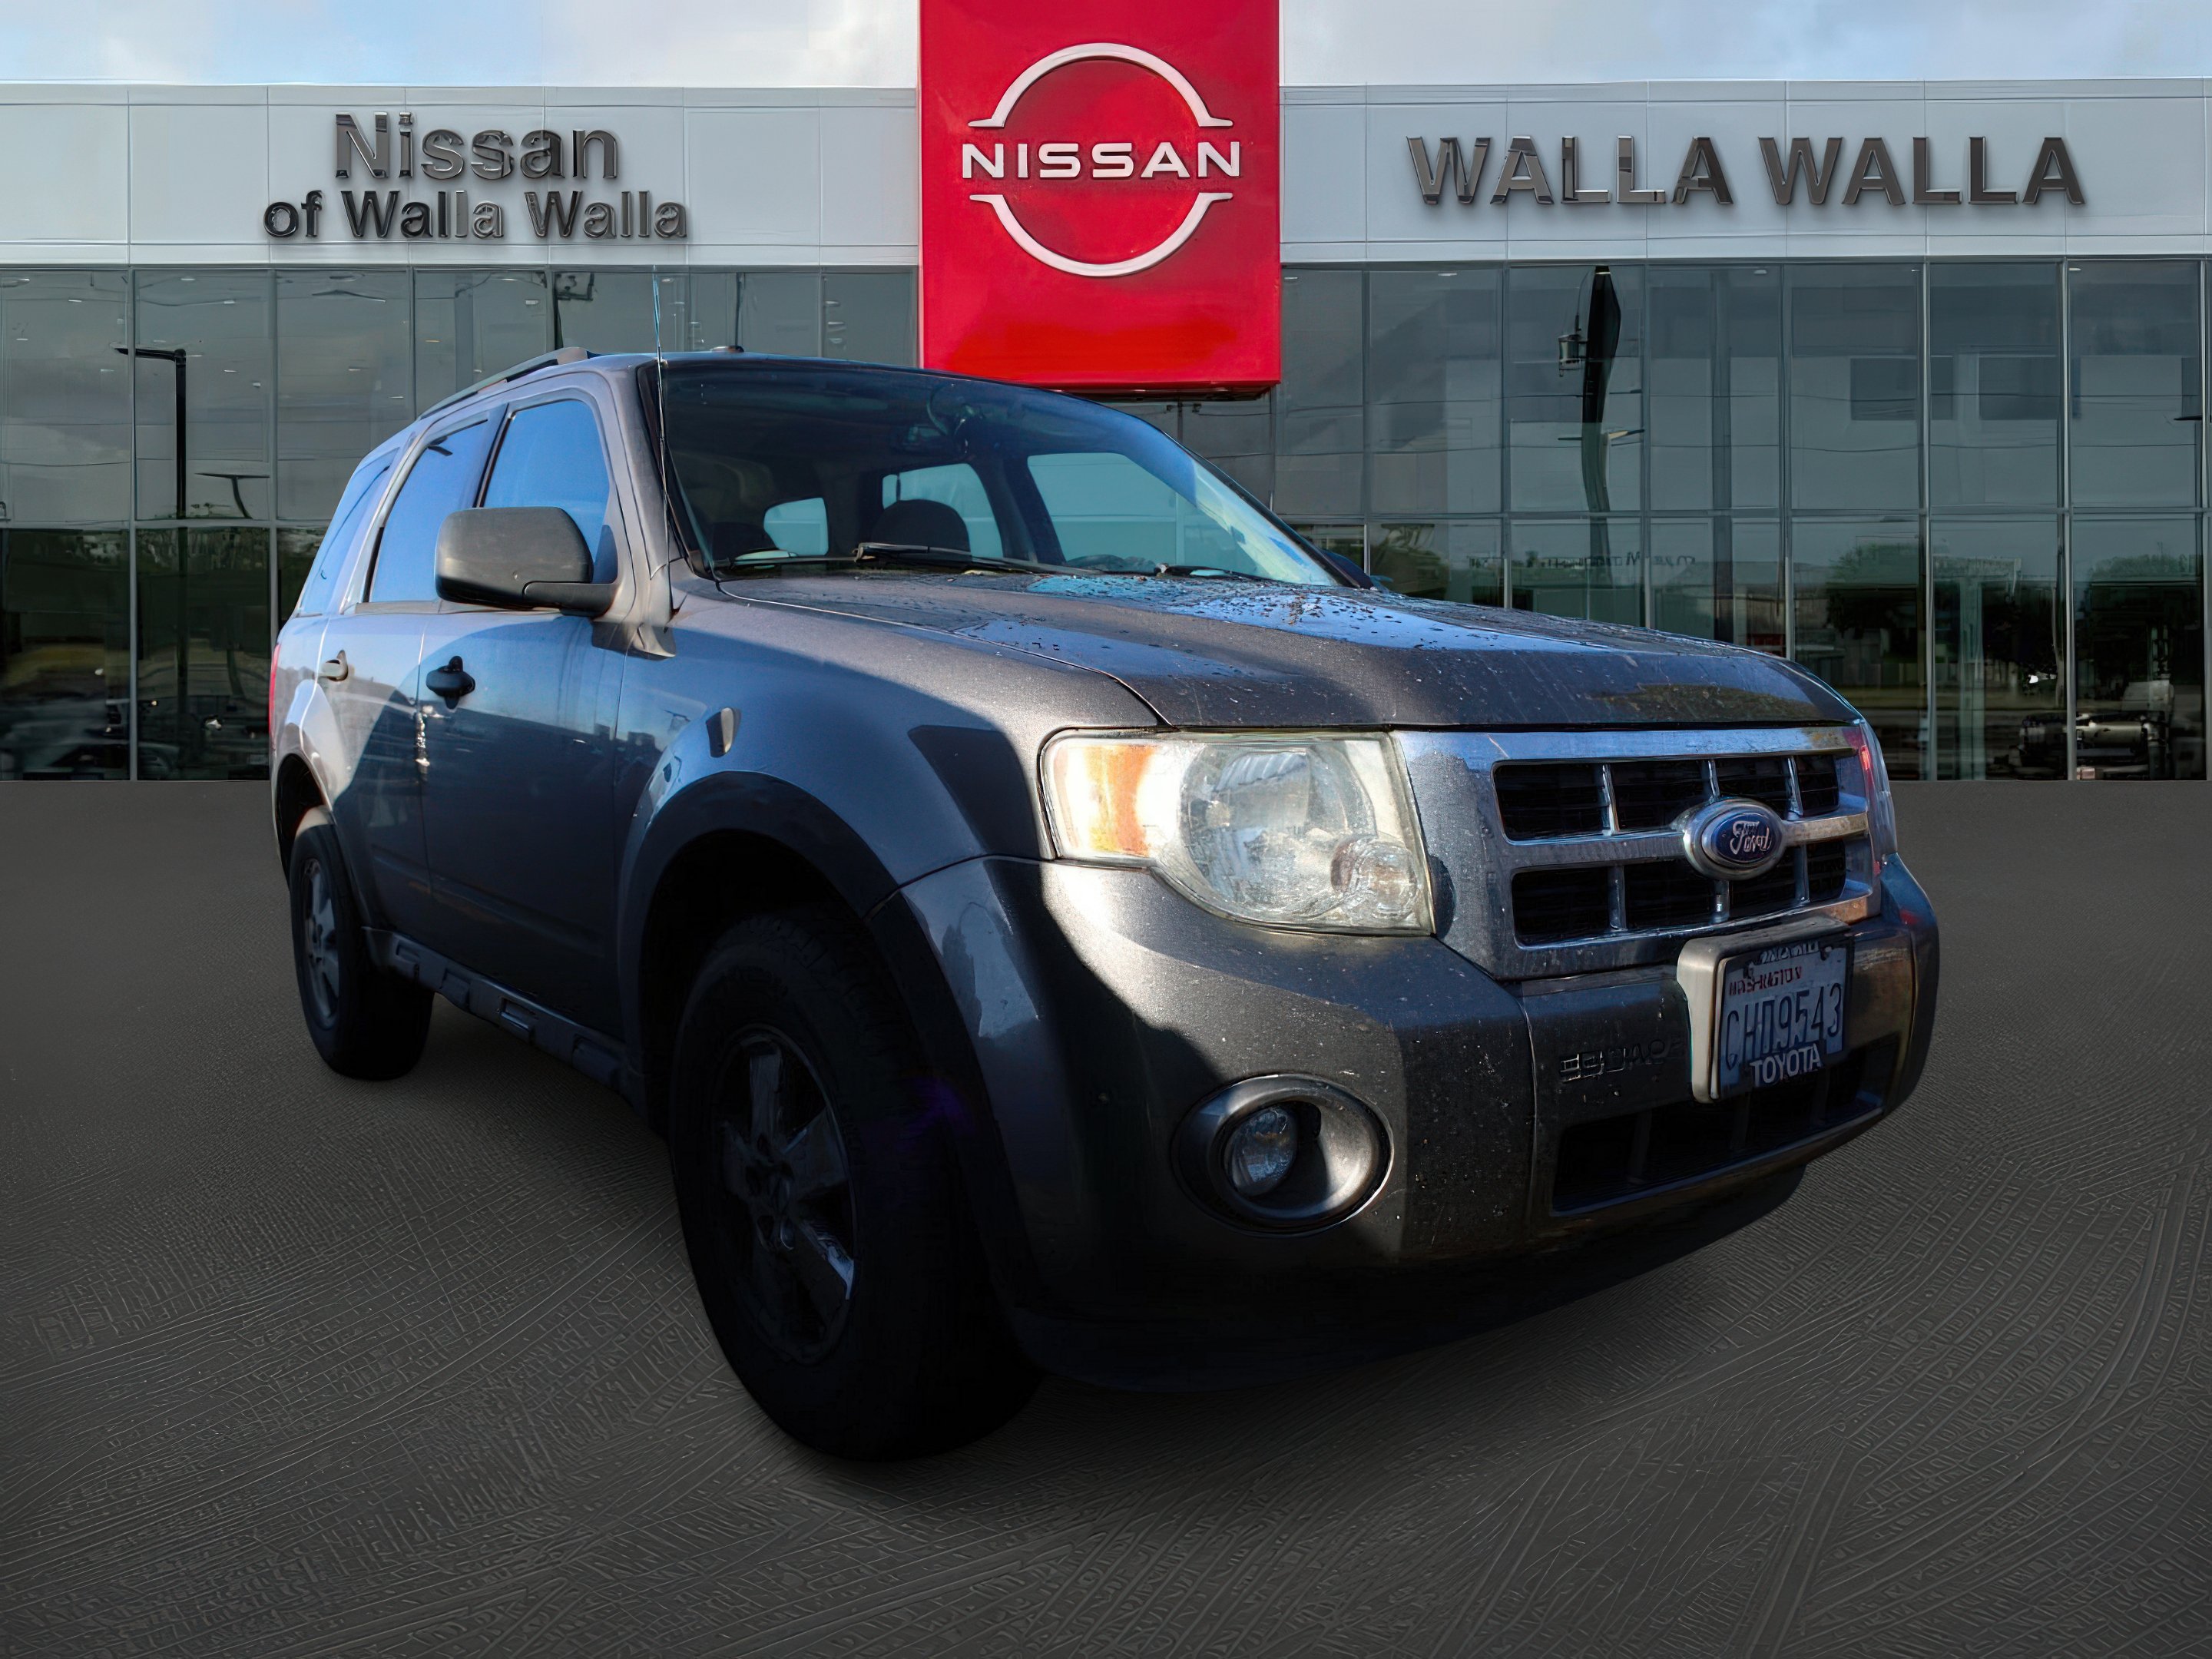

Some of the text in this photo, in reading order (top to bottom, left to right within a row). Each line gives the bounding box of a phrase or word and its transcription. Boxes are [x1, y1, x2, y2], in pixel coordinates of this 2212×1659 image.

[335, 111, 618, 180] Nissan
[962, 141, 1240, 179] NISSAN
[1406, 135, 2086, 206] WALLA WALLA
[263, 190, 688, 239] of Walla Walla
[1730, 820, 1772, 855] Ford
[1750, 1043, 1822, 1088] TOYOTA
